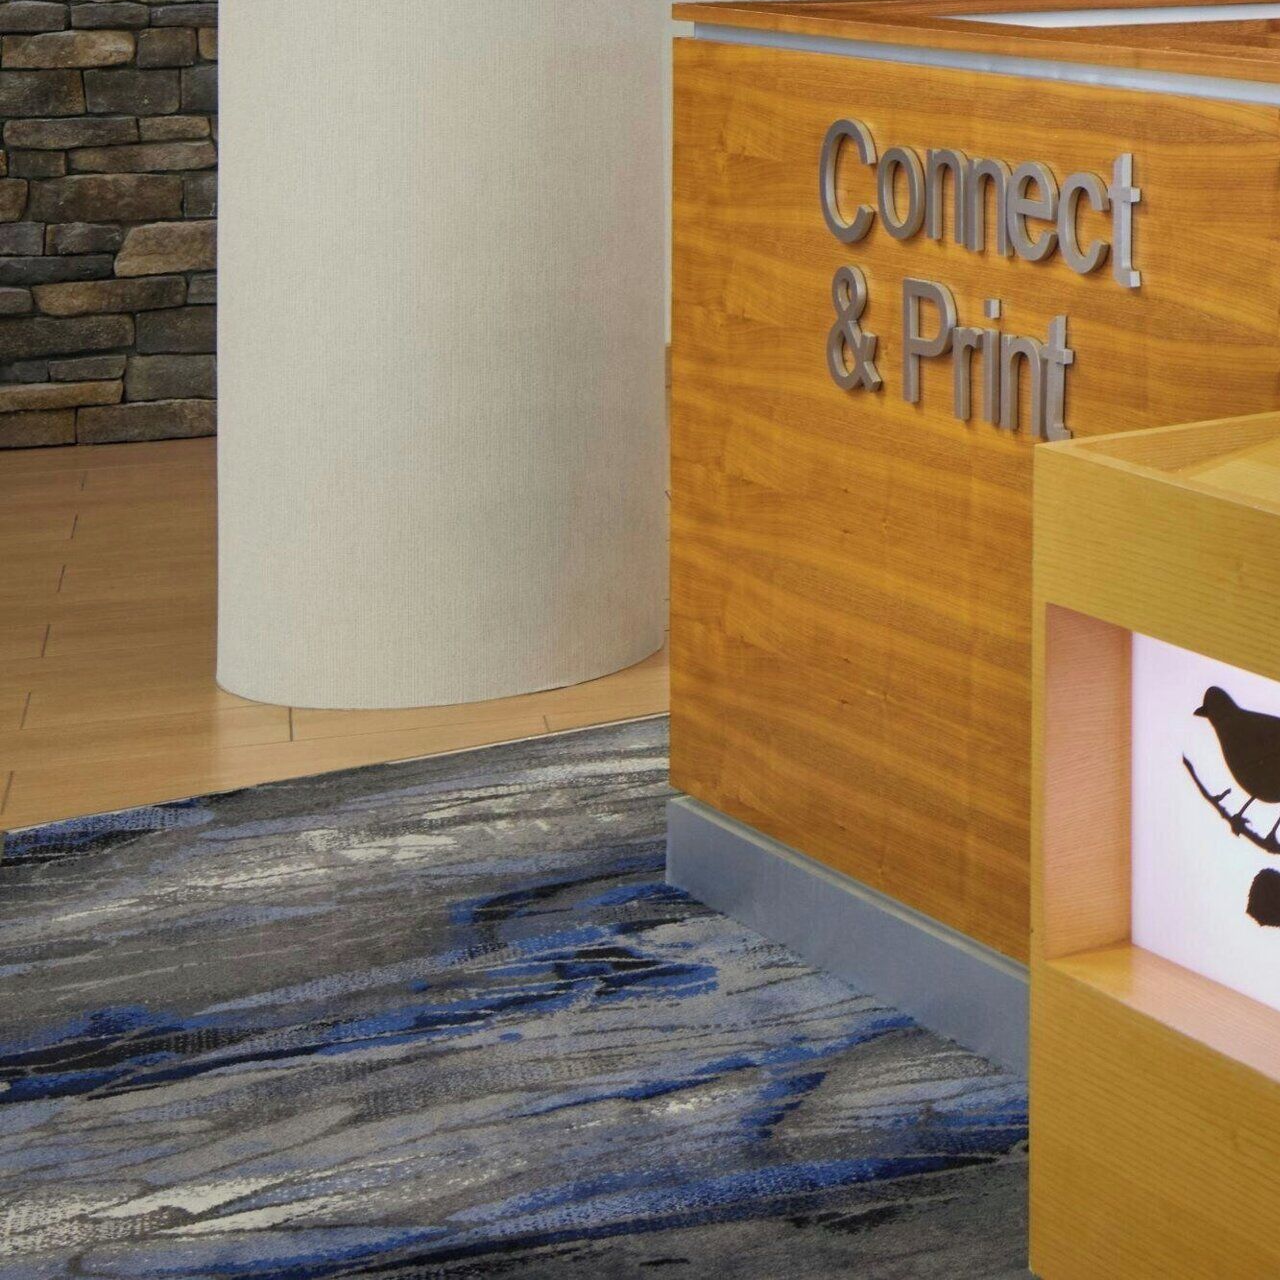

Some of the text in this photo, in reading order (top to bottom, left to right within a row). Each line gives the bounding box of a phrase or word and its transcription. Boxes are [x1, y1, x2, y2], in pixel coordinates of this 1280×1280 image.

[819, 118, 1141, 288] Connect
[826, 265, 1074, 442] & Print
